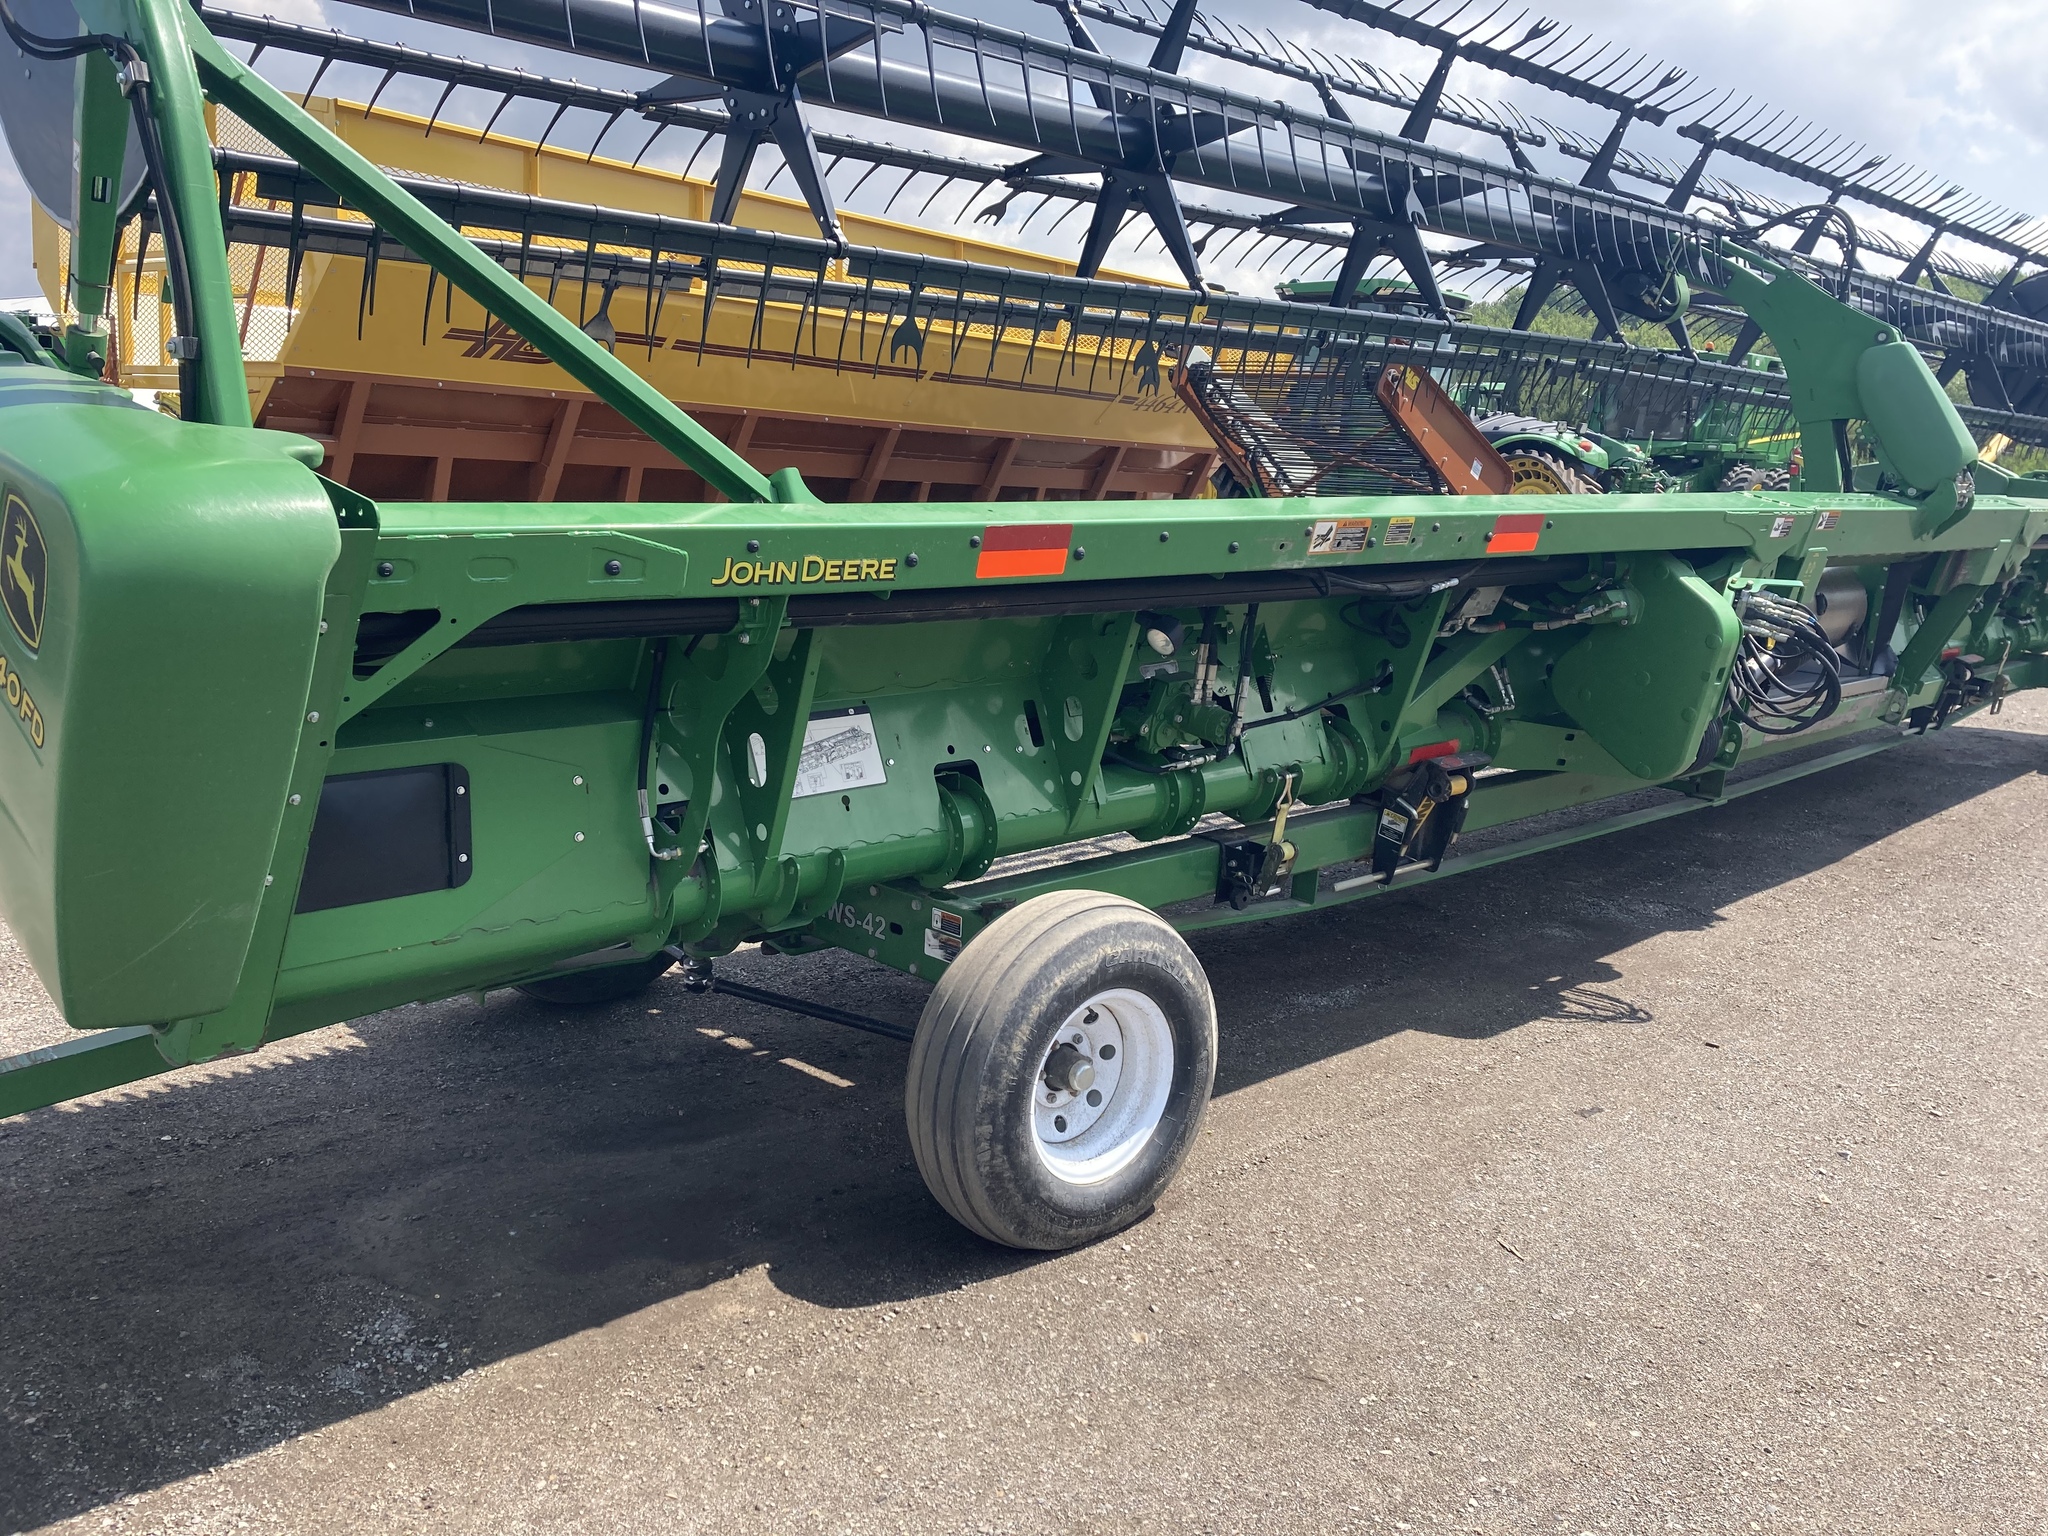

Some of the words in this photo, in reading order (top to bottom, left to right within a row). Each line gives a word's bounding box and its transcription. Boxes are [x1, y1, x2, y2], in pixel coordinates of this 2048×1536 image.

[711, 557, 798, 585] JOHN
[801, 555, 896, 582] DEERE
[822, 901, 886, 940] WS-42
[1105, 947, 1192, 992] CARLISLE
